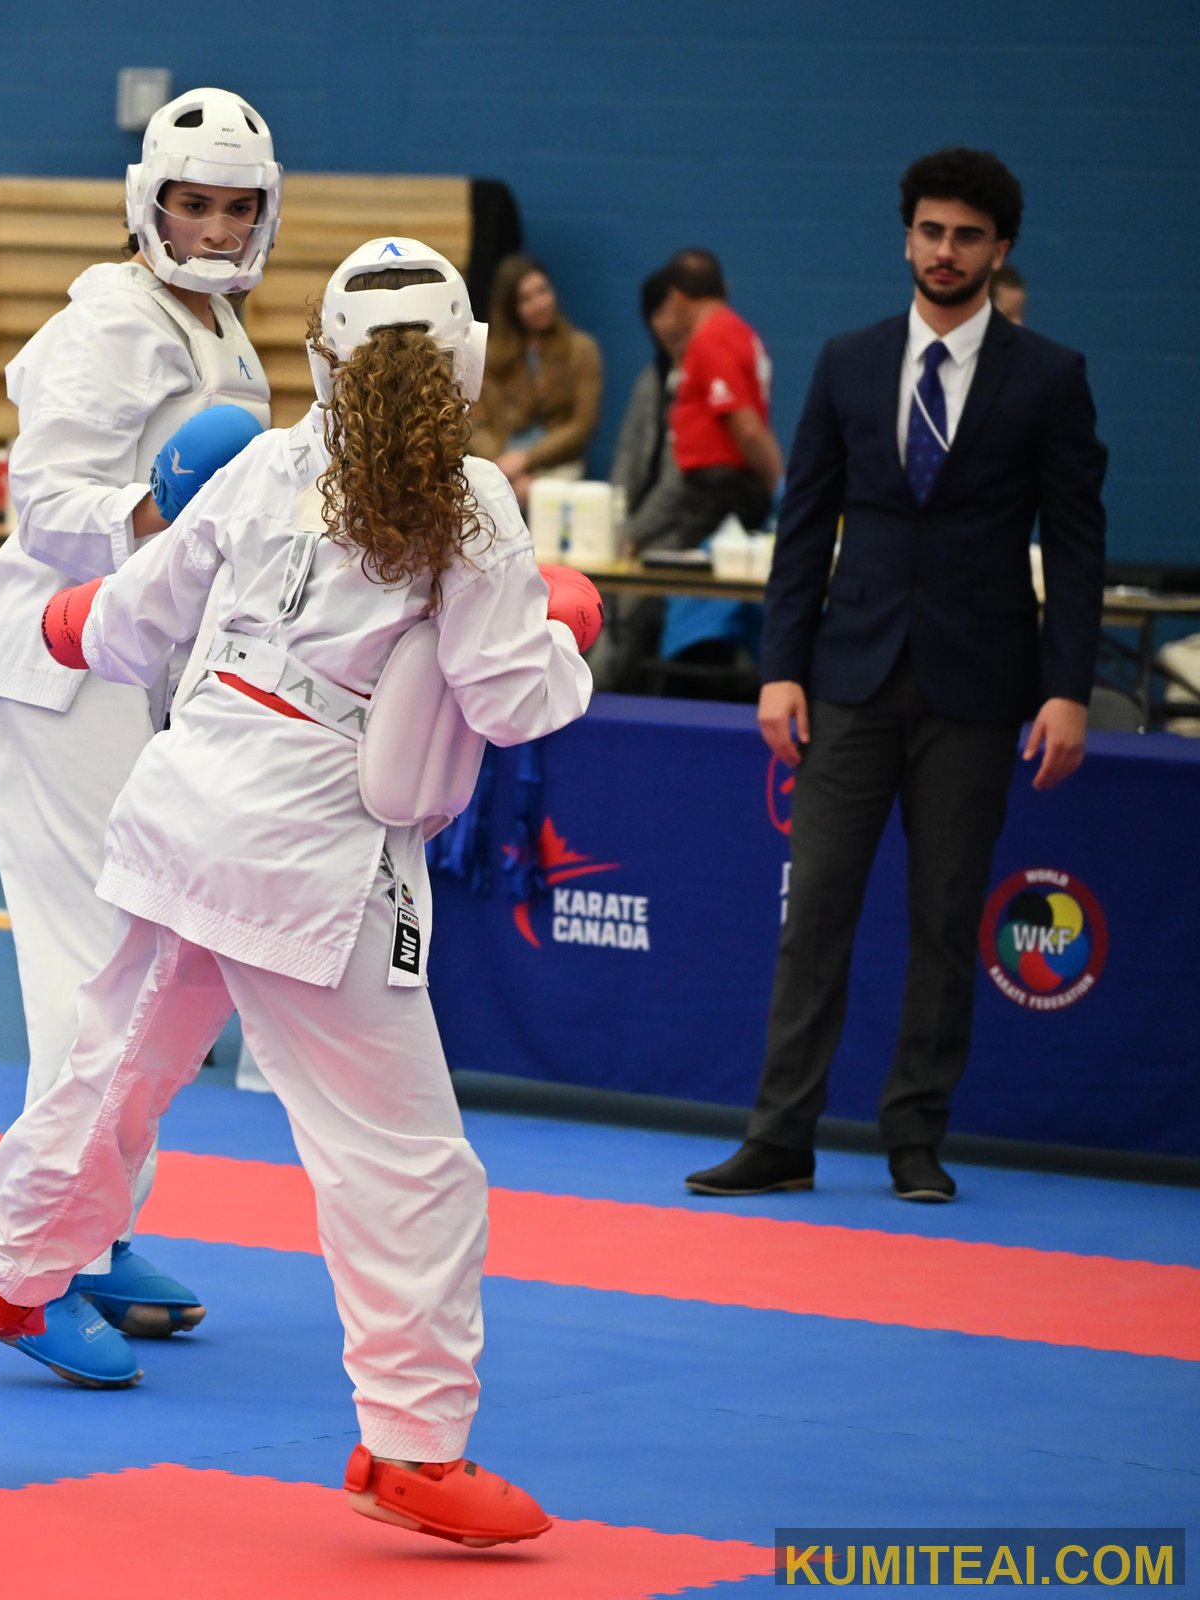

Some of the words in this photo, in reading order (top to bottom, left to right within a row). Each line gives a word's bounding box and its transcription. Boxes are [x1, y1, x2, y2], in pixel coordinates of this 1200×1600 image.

[1025, 868, 1070, 888] WORLD
[553, 887, 649, 923] KARATE
[399, 928, 418, 966] JIN
[552, 915, 651, 952] CANADA
[1012, 923, 1073, 956] WKF
[1028, 972, 1095, 1010] FEDERATION
